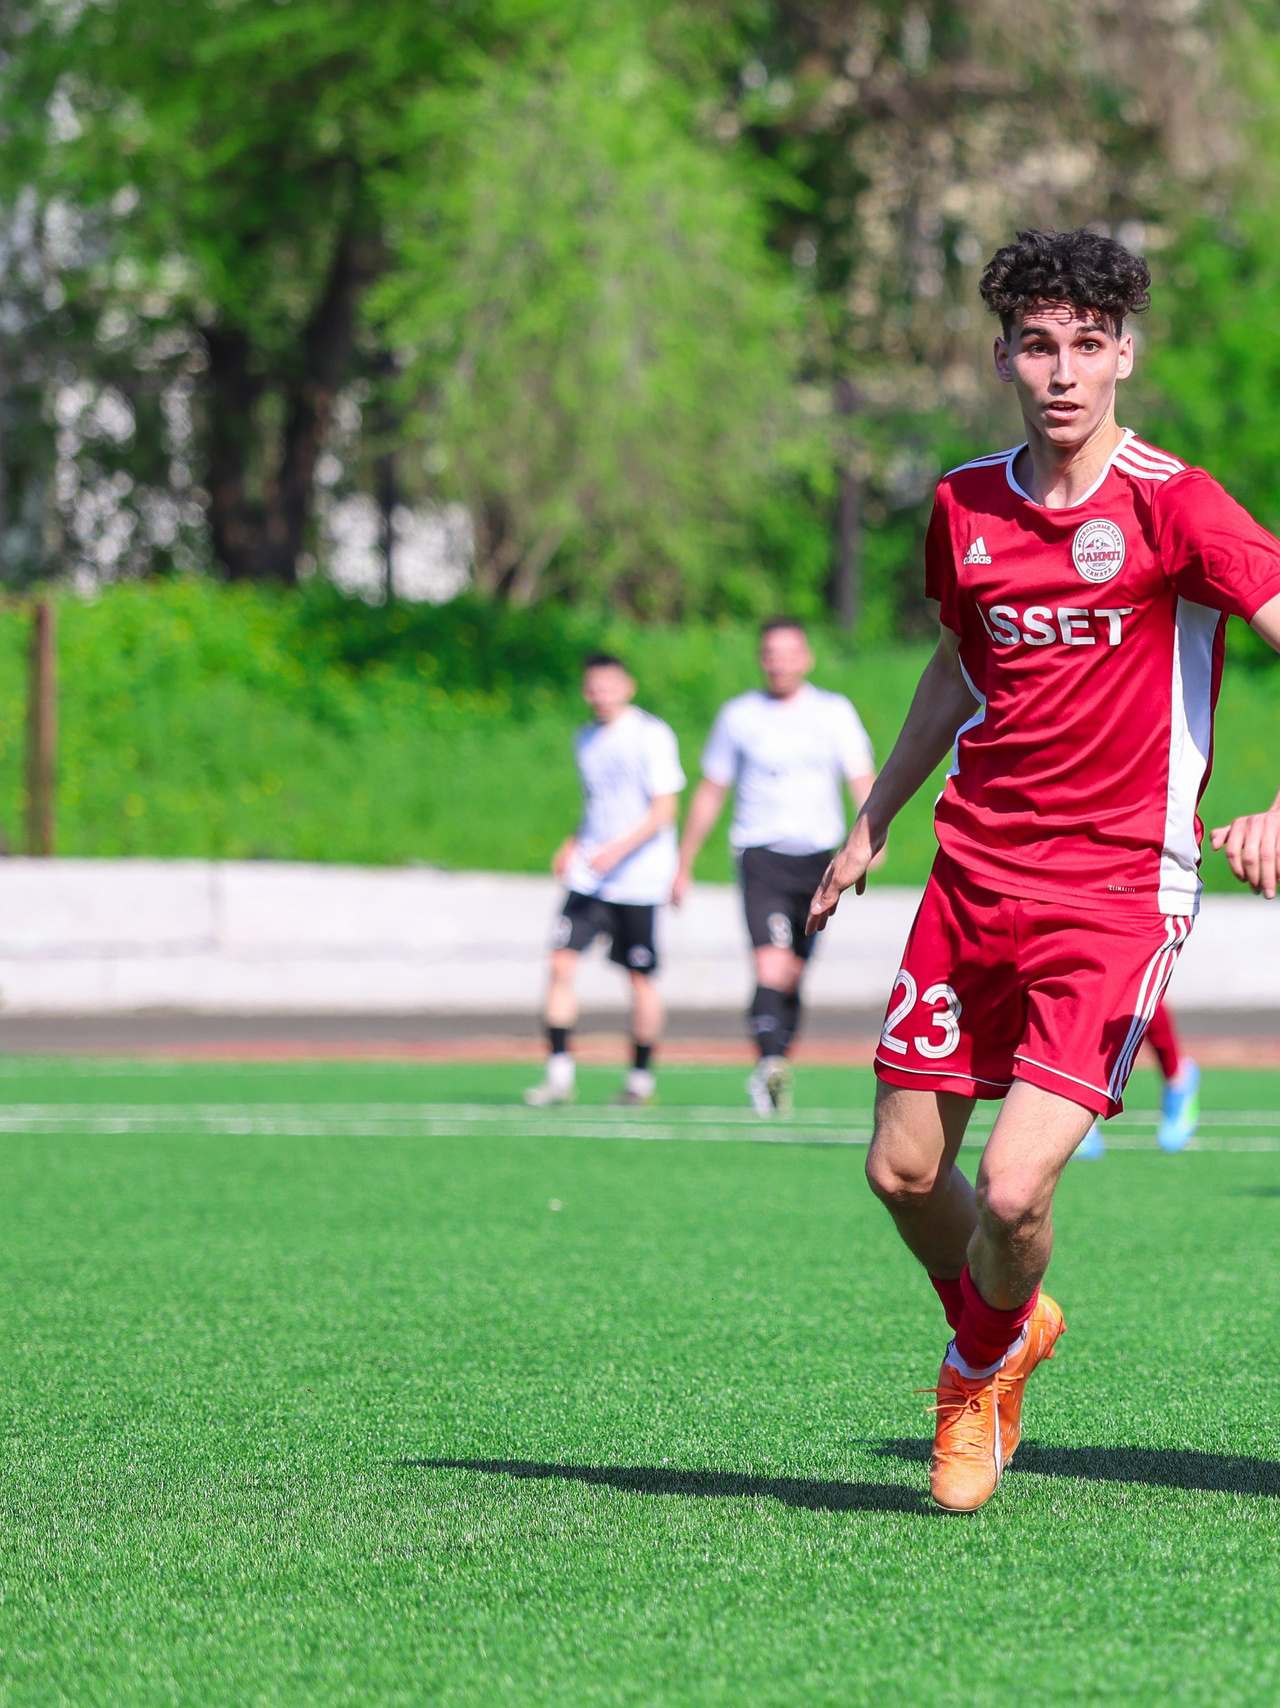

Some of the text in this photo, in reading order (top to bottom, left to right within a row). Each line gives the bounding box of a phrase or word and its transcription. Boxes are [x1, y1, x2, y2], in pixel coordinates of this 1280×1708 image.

[1077, 551, 1121, 563] ОЛИМП
[1085, 567, 1113, 577] САМАРА
[975, 602, 1133, 646] SSET
[880, 968, 962, 1059] 23
